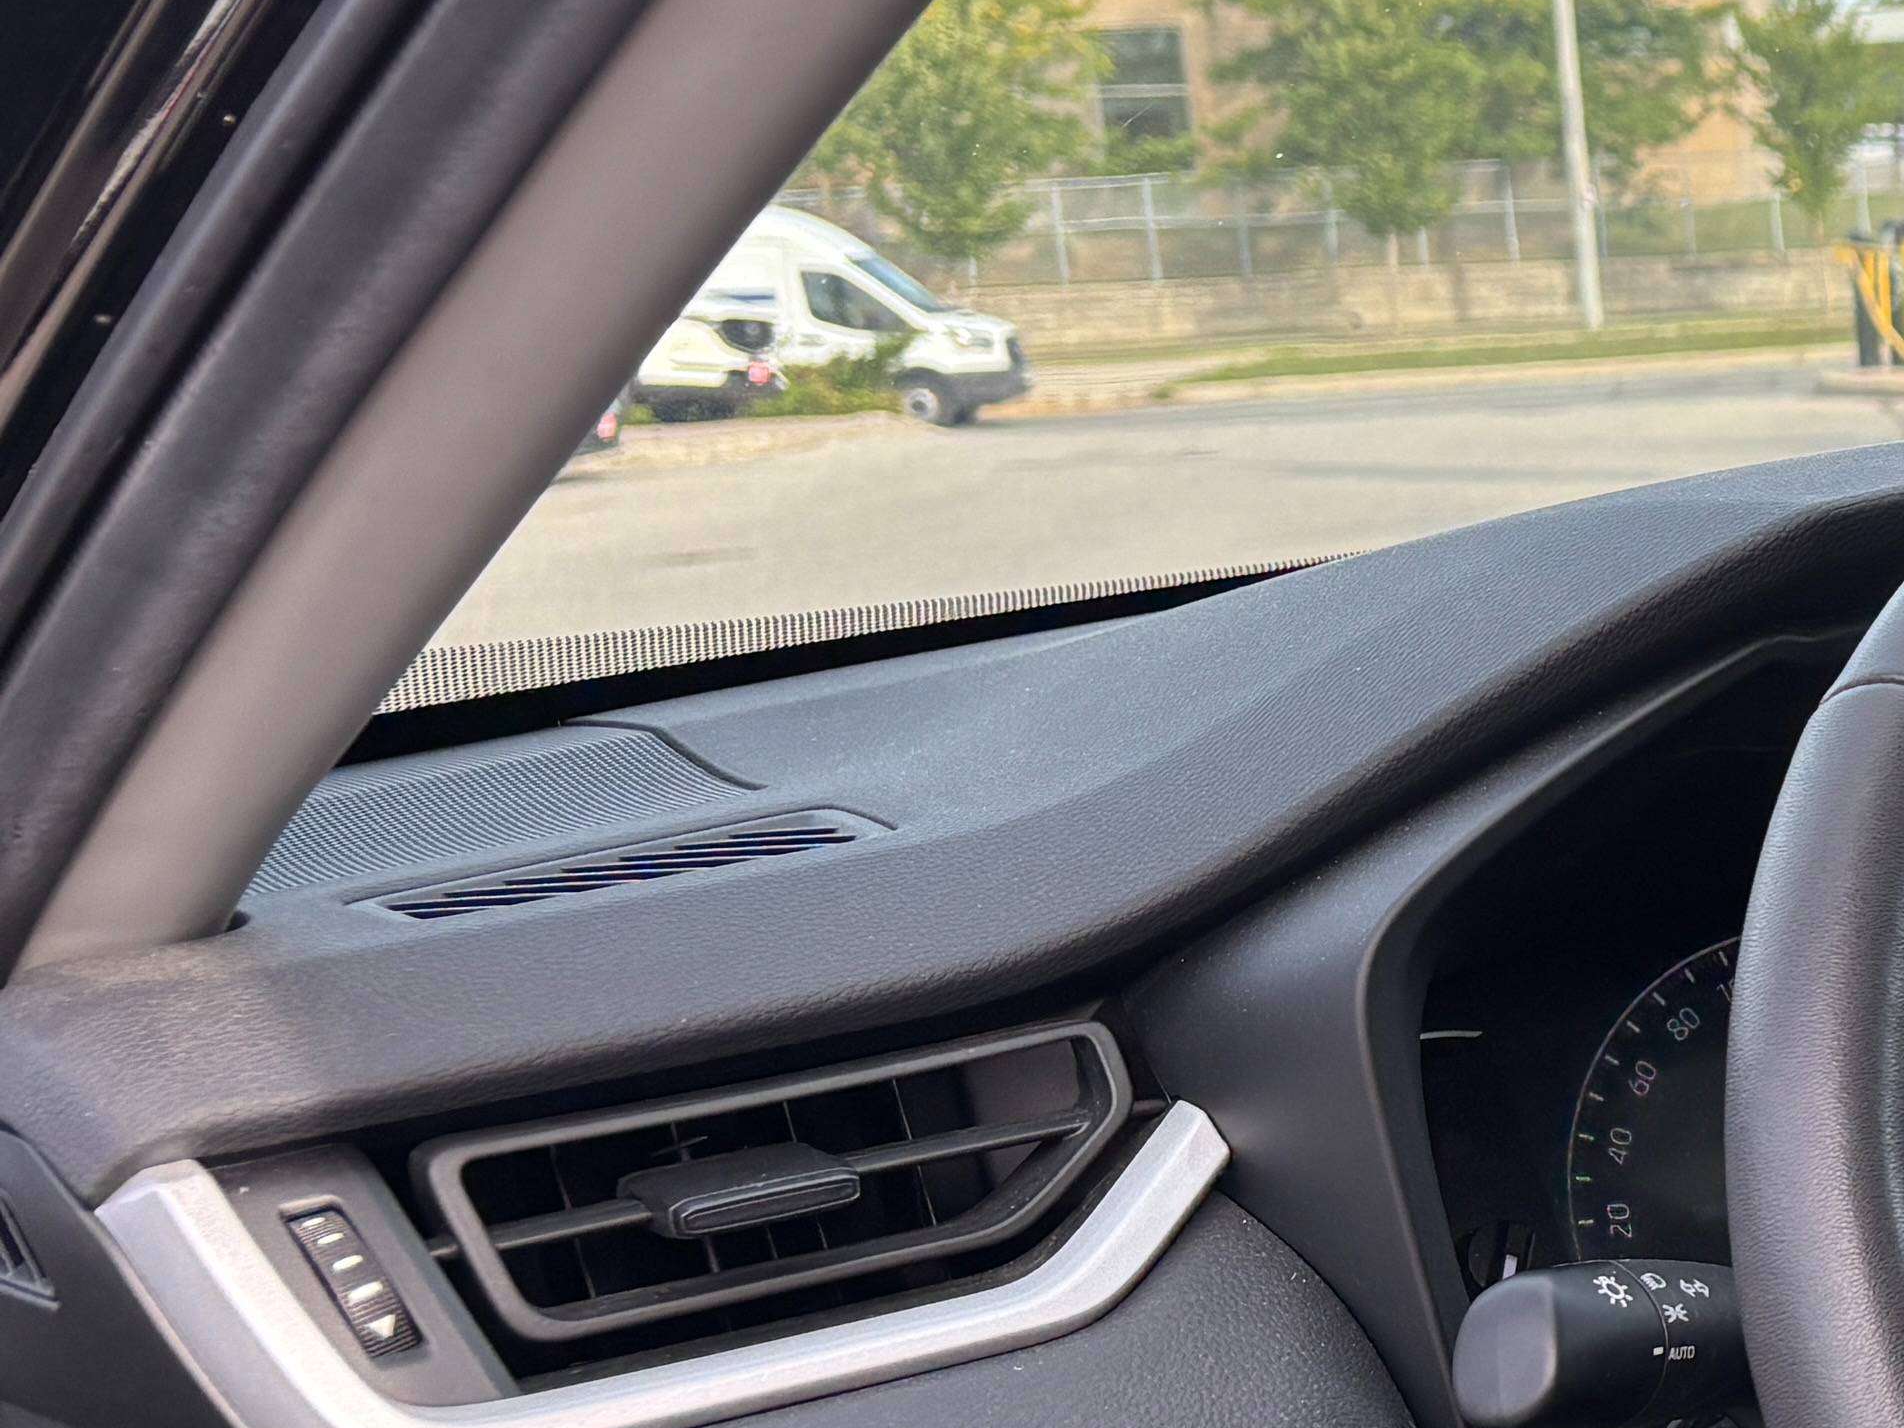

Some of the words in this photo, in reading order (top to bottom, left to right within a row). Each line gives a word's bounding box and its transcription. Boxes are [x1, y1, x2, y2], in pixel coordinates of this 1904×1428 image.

[1666, 1007, 1700, 1042] 80
[1628, 1060, 1657, 1096] 60
[1608, 1127, 1633, 1166] 40
[1606, 1202, 1633, 1239] 20
[1668, 1345, 1696, 1361] AUTO
